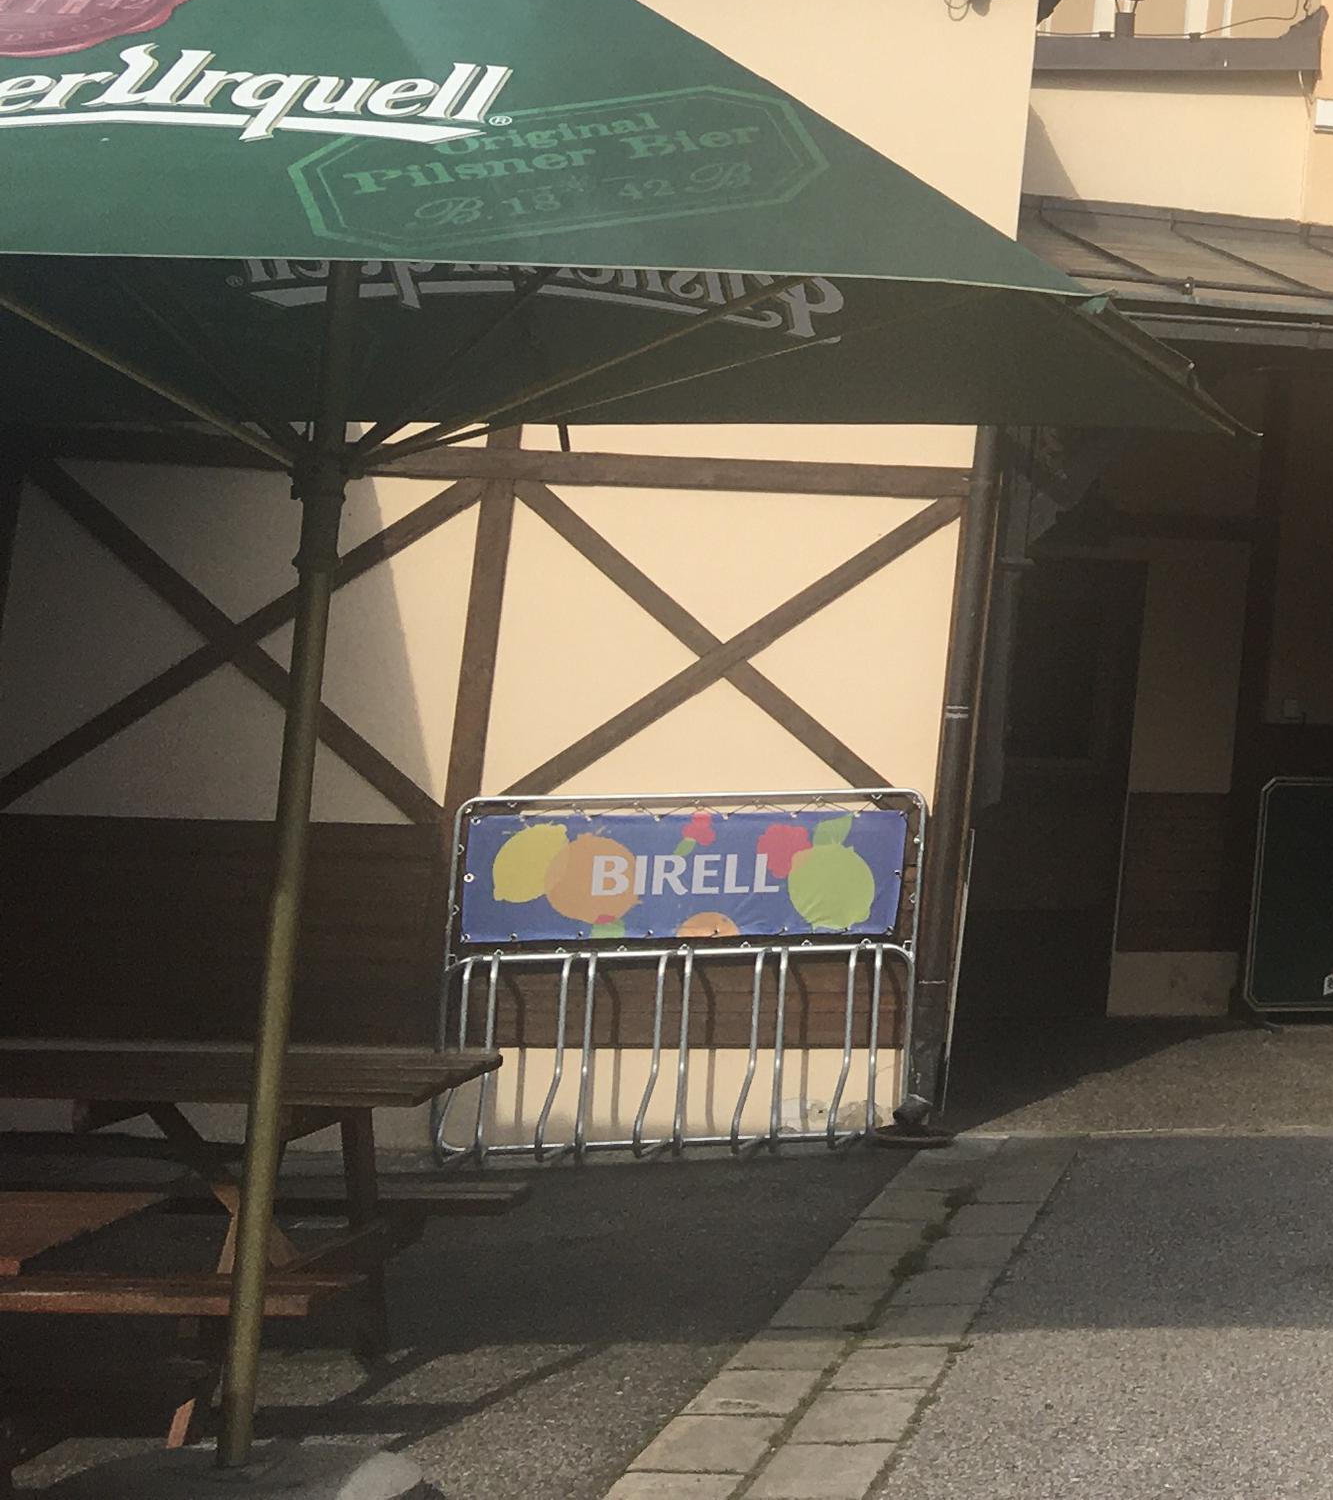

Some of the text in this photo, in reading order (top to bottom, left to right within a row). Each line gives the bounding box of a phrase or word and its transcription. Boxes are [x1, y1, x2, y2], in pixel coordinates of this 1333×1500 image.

[83, 43, 514, 143] Urquell
[343, 125, 761, 195] Pilsner Bier
[590, 852, 780, 897] BIRELL
